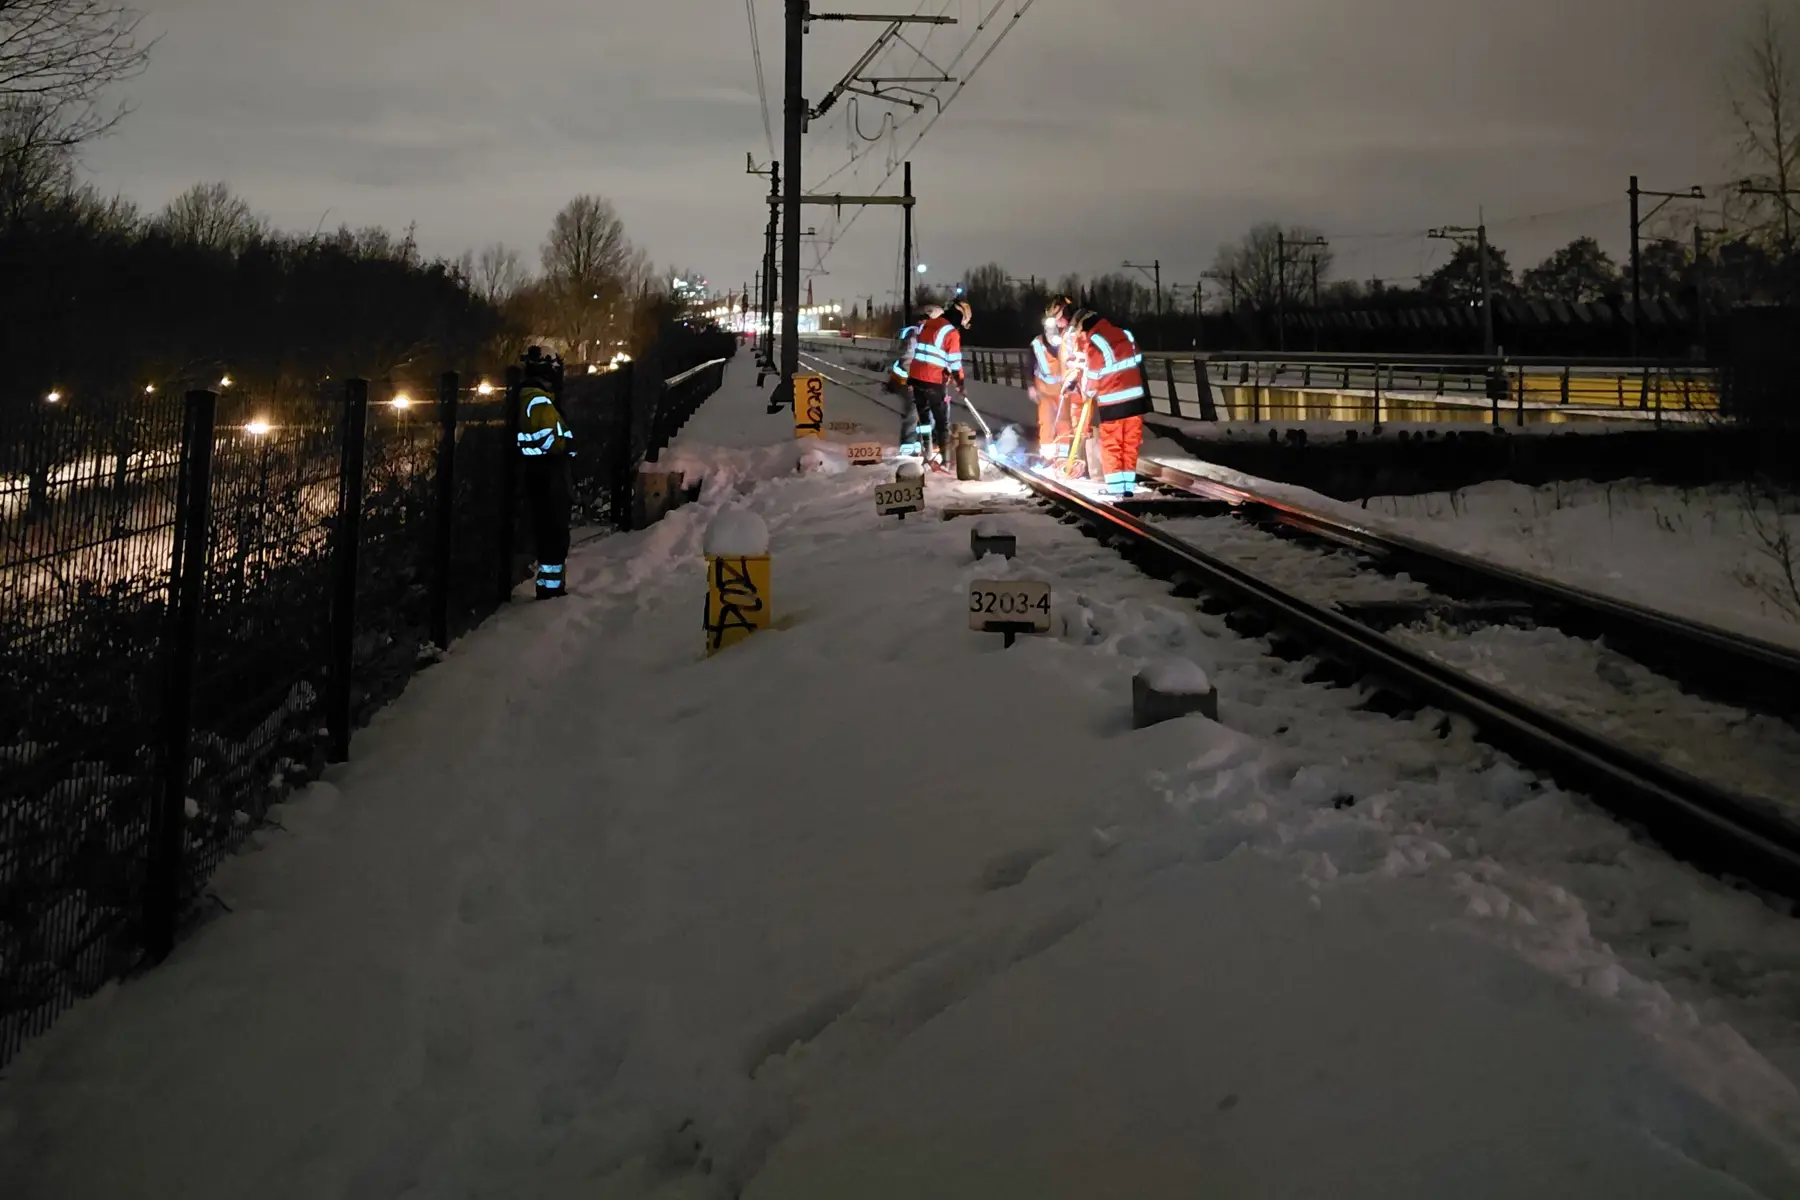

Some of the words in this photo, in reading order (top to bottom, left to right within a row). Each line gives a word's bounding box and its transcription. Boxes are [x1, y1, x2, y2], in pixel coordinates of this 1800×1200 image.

[847, 446, 881, 458] 3203-2
[875, 486, 924, 505] 3203-3
[970, 591, 1050, 615] 3203-4
